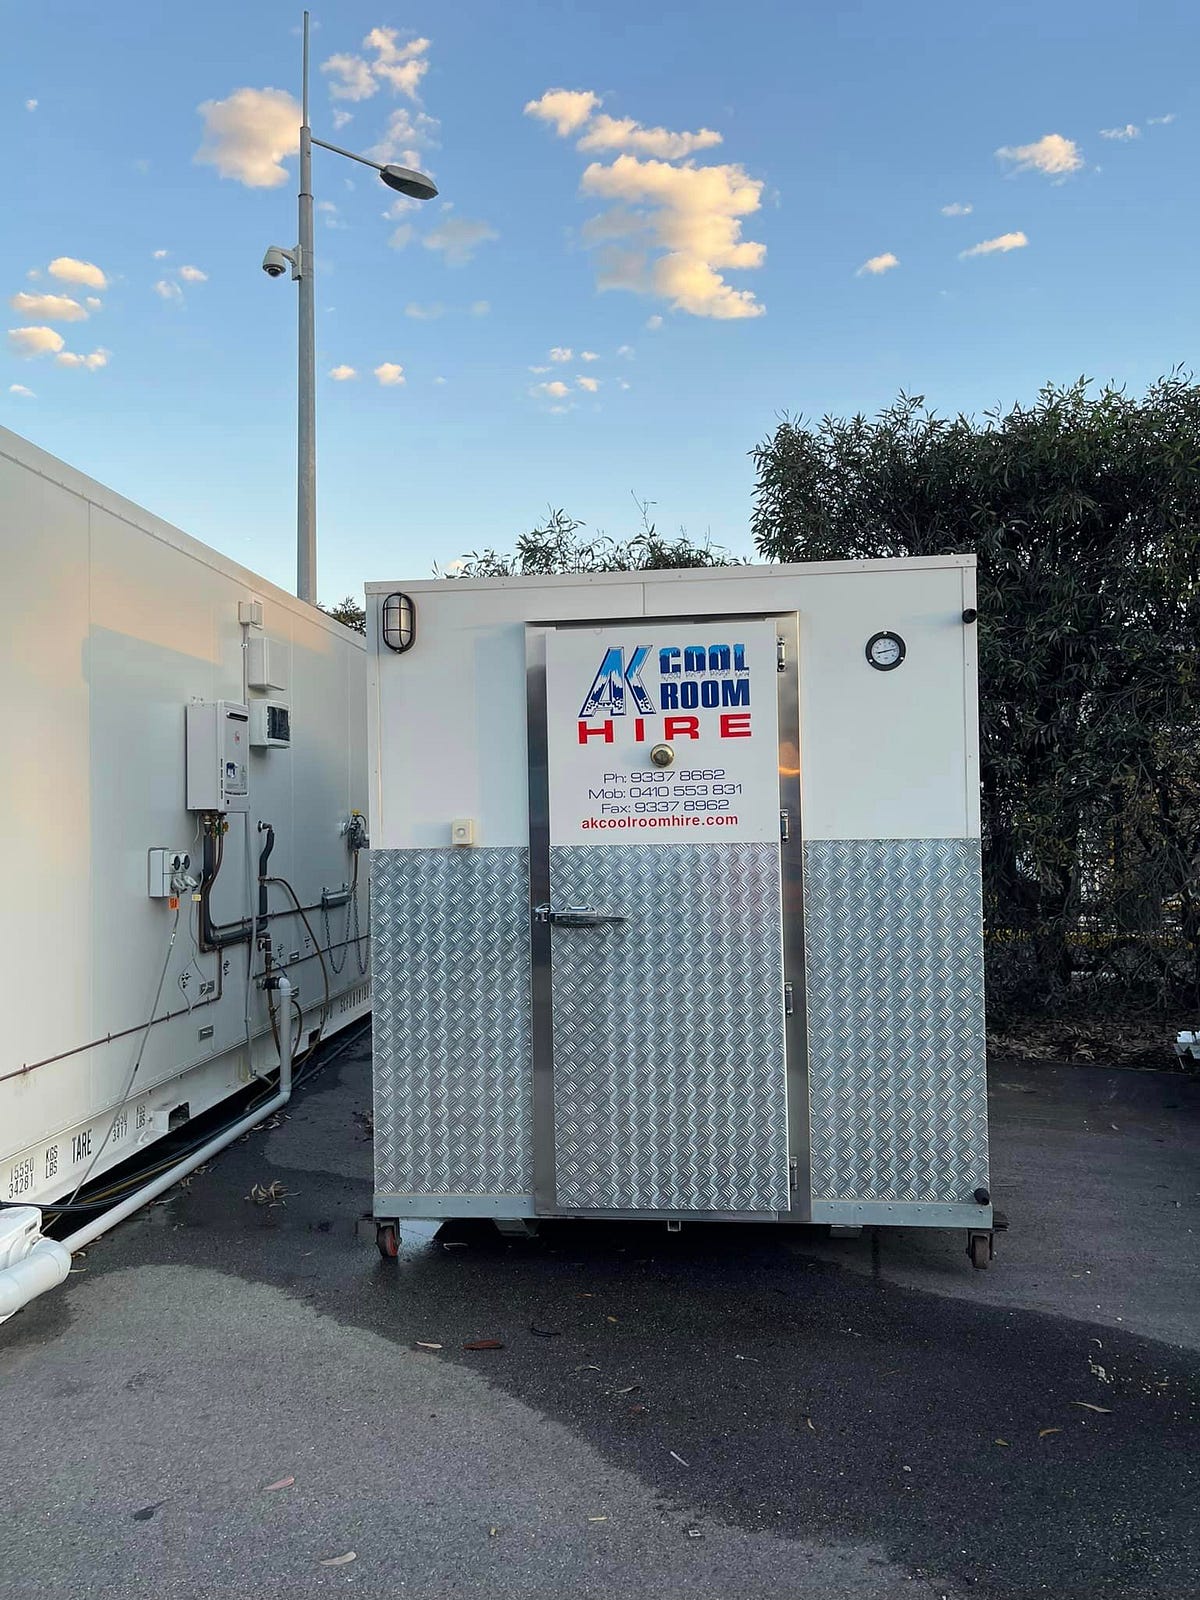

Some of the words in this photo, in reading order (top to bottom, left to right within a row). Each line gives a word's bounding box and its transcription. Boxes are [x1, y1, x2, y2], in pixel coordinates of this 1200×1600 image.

[659, 644, 750, 678] COOL
[578, 645, 656, 718] AK
[660, 679, 750, 710] ROOM
[577, 713, 752, 744] HIRE
[588, 788, 626, 800] Mob:
[629, 786, 669, 798] 0410
[673, 785, 708, 797] 553
[712, 783, 742, 795] 831
[603, 773, 627, 784] Ph:
[630, 771, 675, 783] 9337
[680, 769, 725, 781] 8662
[581, 814, 738, 829] akcoolroomhire.com
[601, 802, 631, 814] Fax:
[634, 801, 679, 813] 9337
[683, 799, 730, 811] 8962
[10, 1158, 35, 1182] 15550
[46, 1145, 58, 1163] KGS
[71, 1129, 92, 1164] TARE
[8, 1172, 33, 1199] 34281
[45, 1159, 58, 1179] LBS
